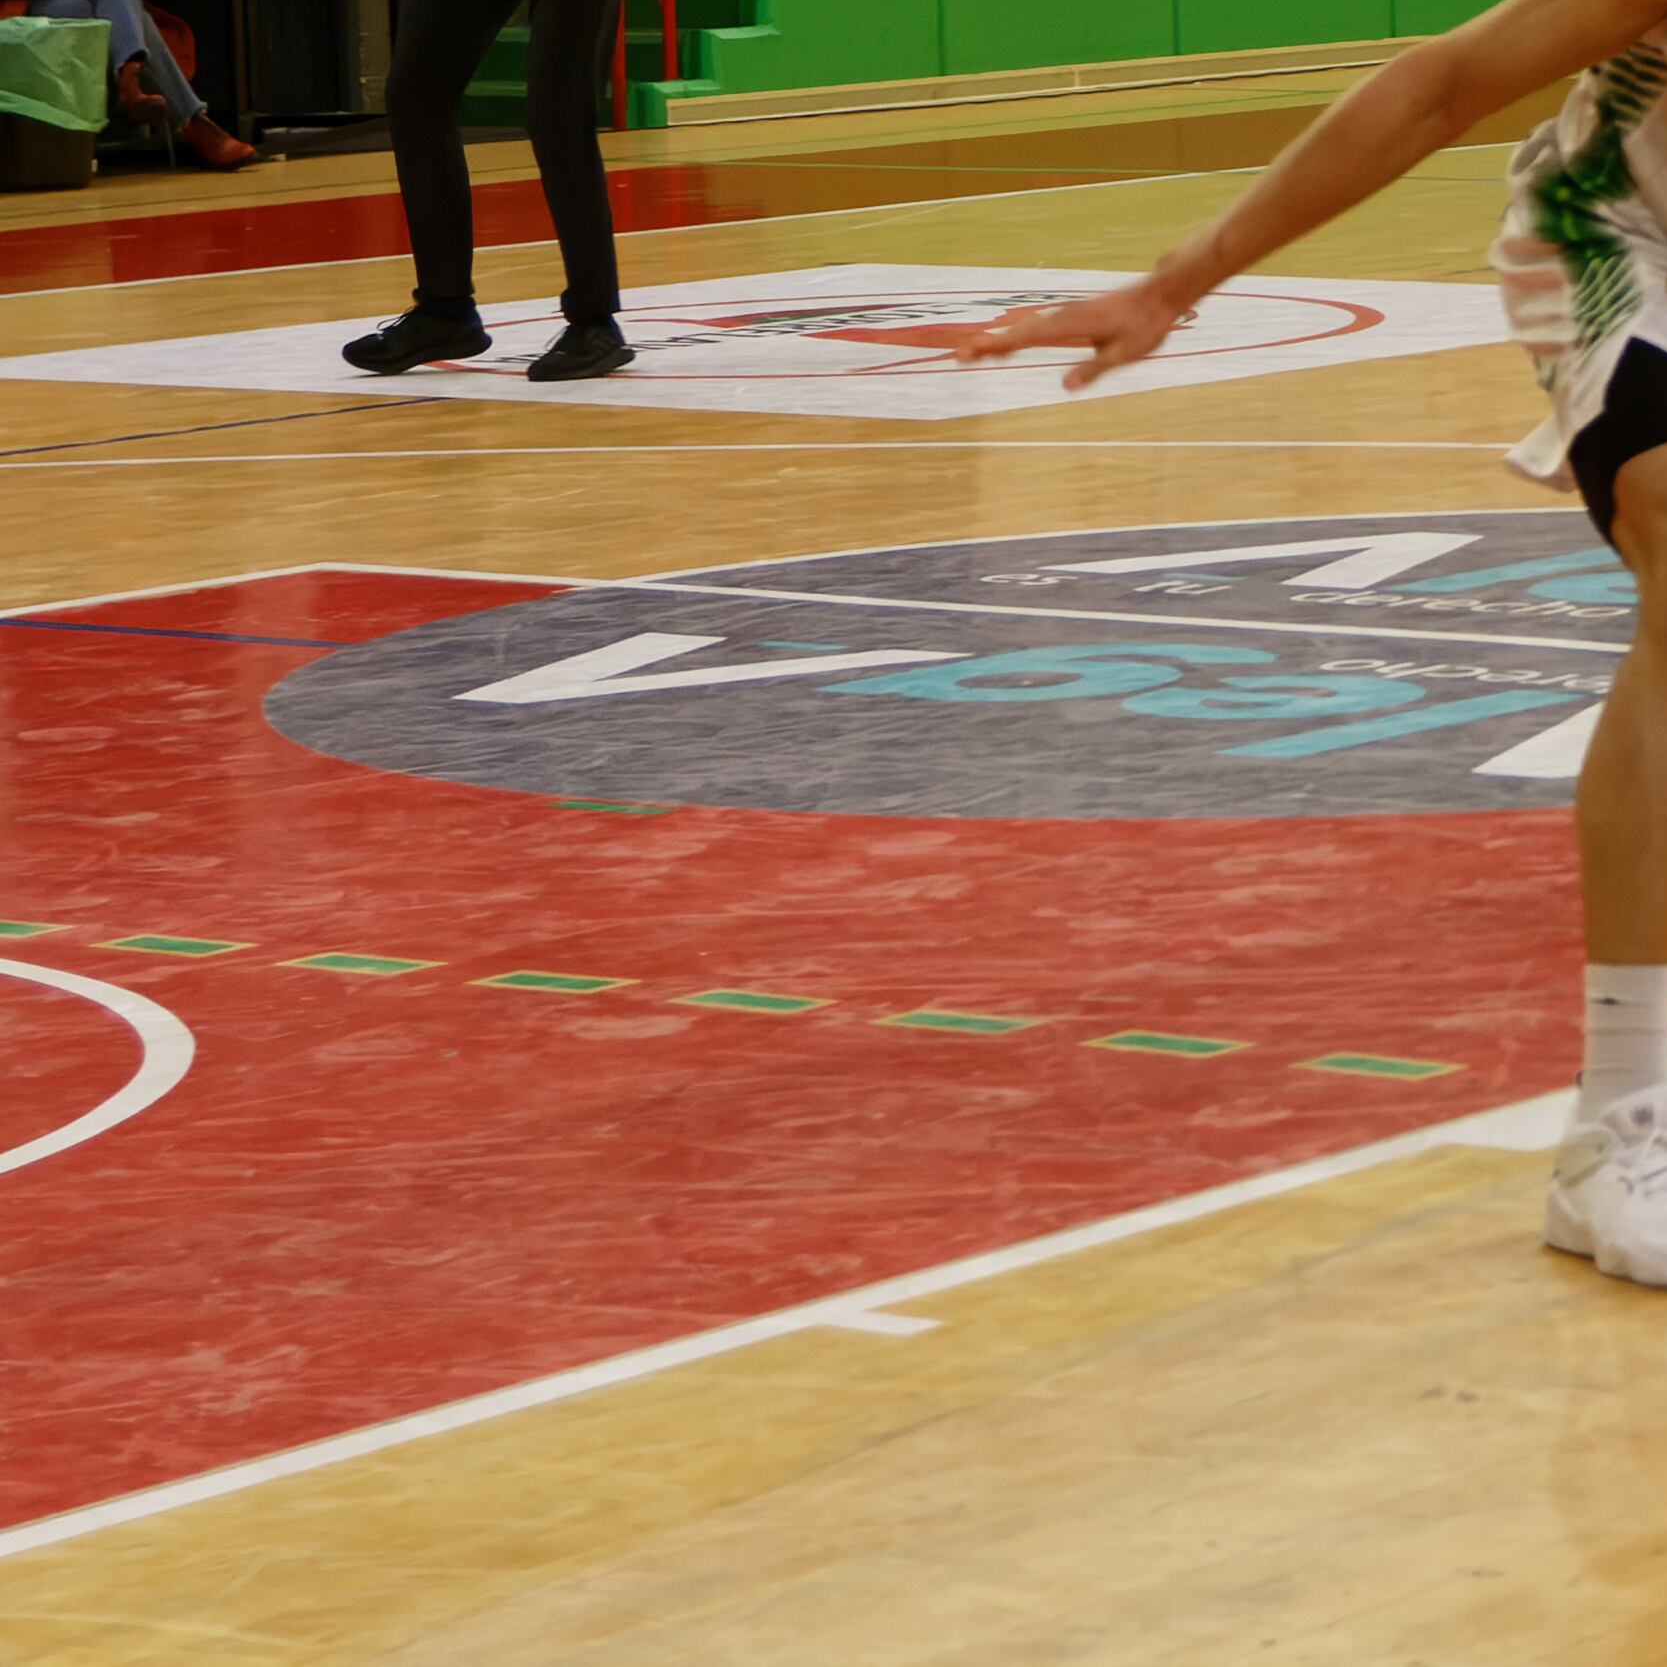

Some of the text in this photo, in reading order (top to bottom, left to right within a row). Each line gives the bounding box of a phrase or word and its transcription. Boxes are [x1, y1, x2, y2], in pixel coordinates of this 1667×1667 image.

[977, 569, 1632, 620] es tu derecho
[1318, 654, 1610, 697] erecho
